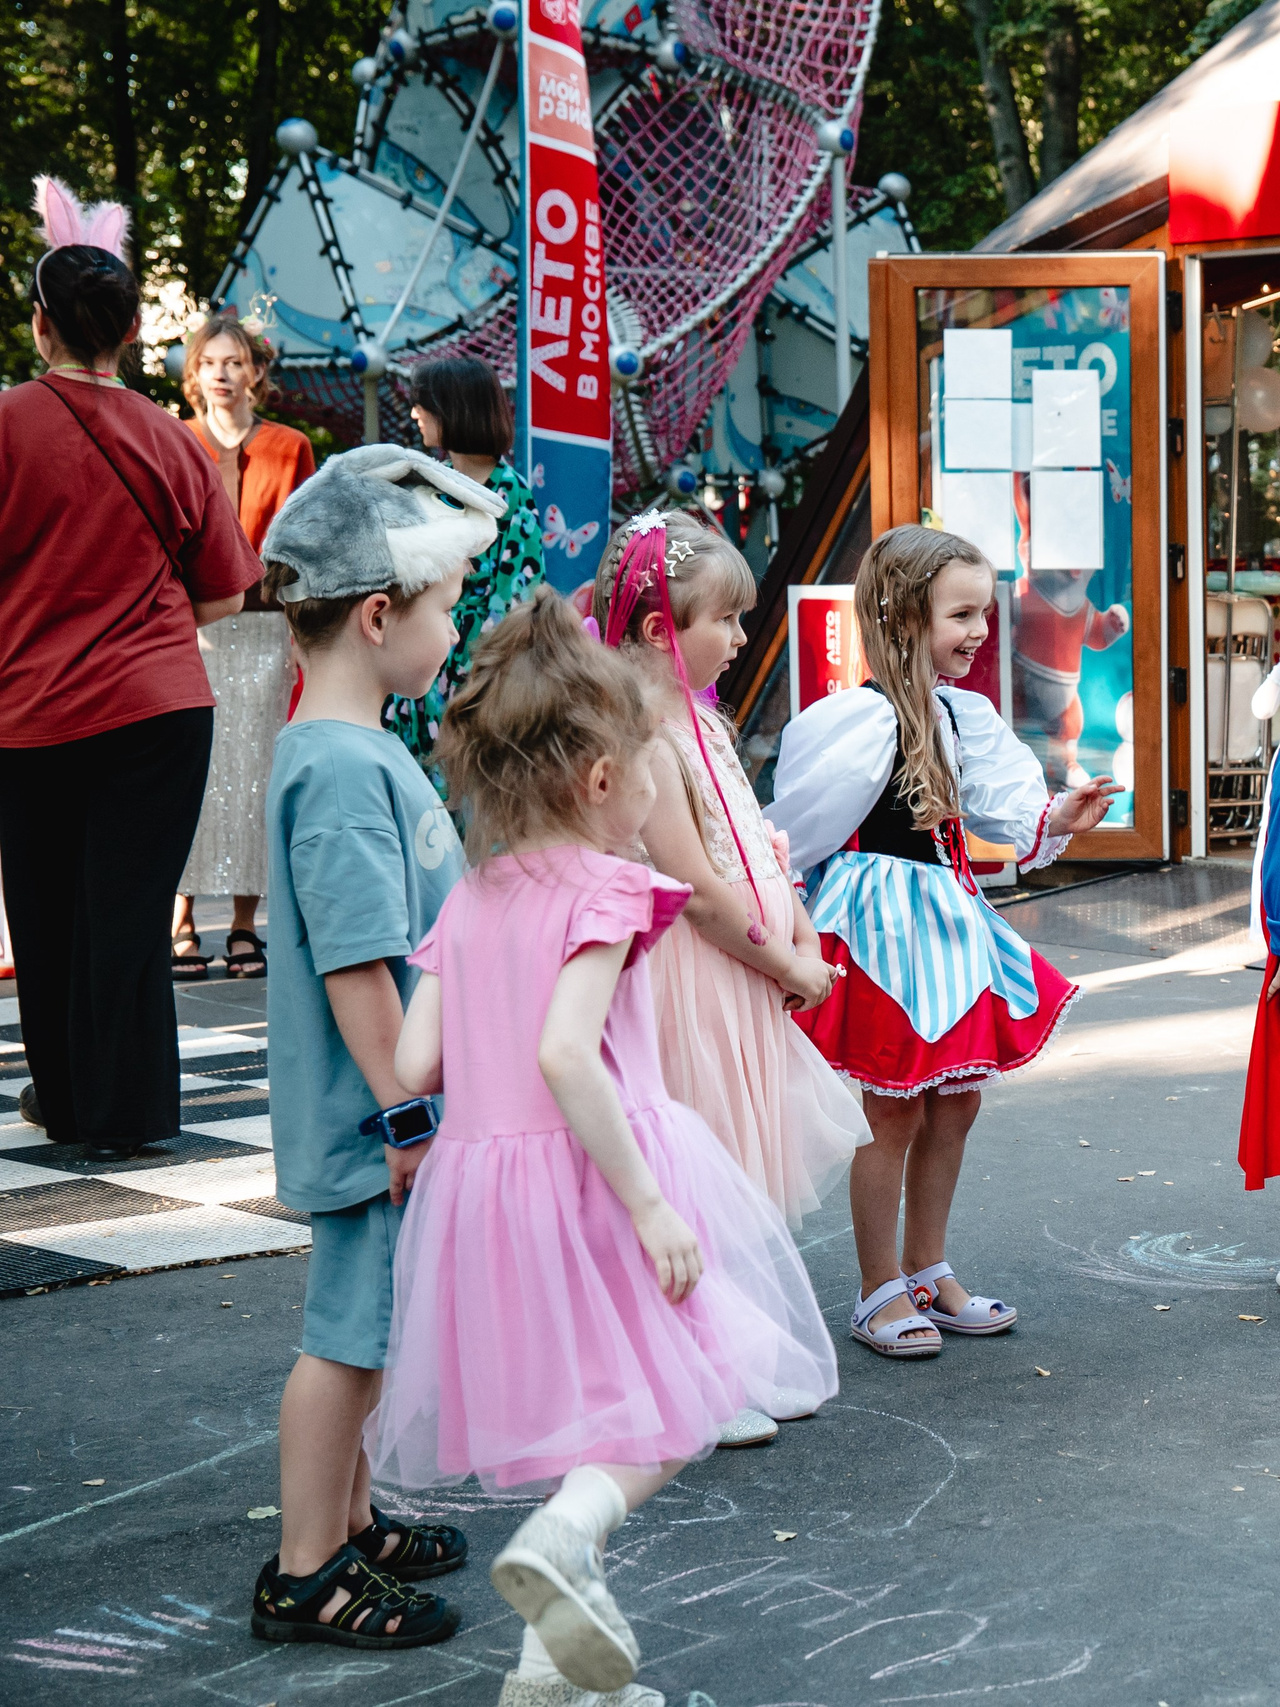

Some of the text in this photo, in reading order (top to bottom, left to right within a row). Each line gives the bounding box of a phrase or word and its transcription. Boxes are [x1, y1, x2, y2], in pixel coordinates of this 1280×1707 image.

[531, 188, 579, 393] ЛЕТО
[576, 198, 600, 400] В МОСКВЕ
